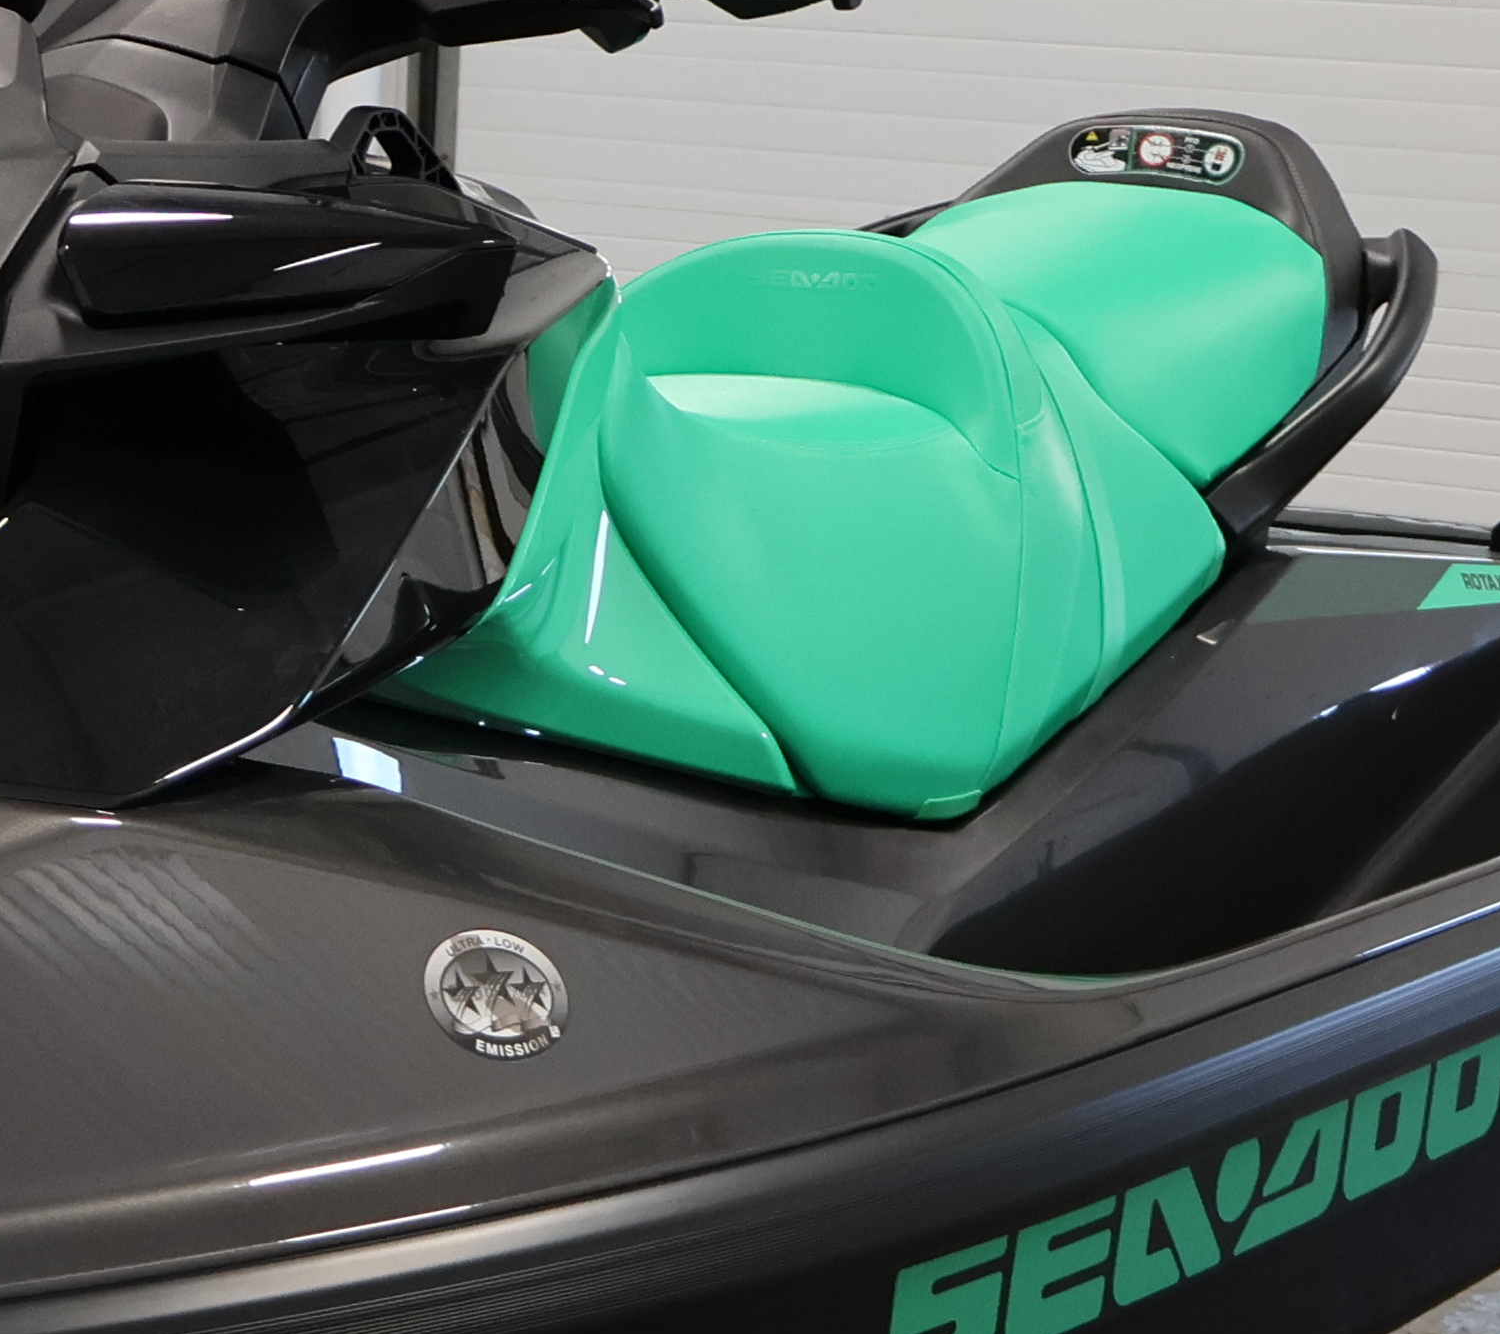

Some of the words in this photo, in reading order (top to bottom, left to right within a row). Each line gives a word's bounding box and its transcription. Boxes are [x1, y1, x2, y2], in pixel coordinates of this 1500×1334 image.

[446, 935, 485, 957] ULTRA
[493, 936, 526, 954] LOW
[475, 1033, 549, 1057] EMISSION
